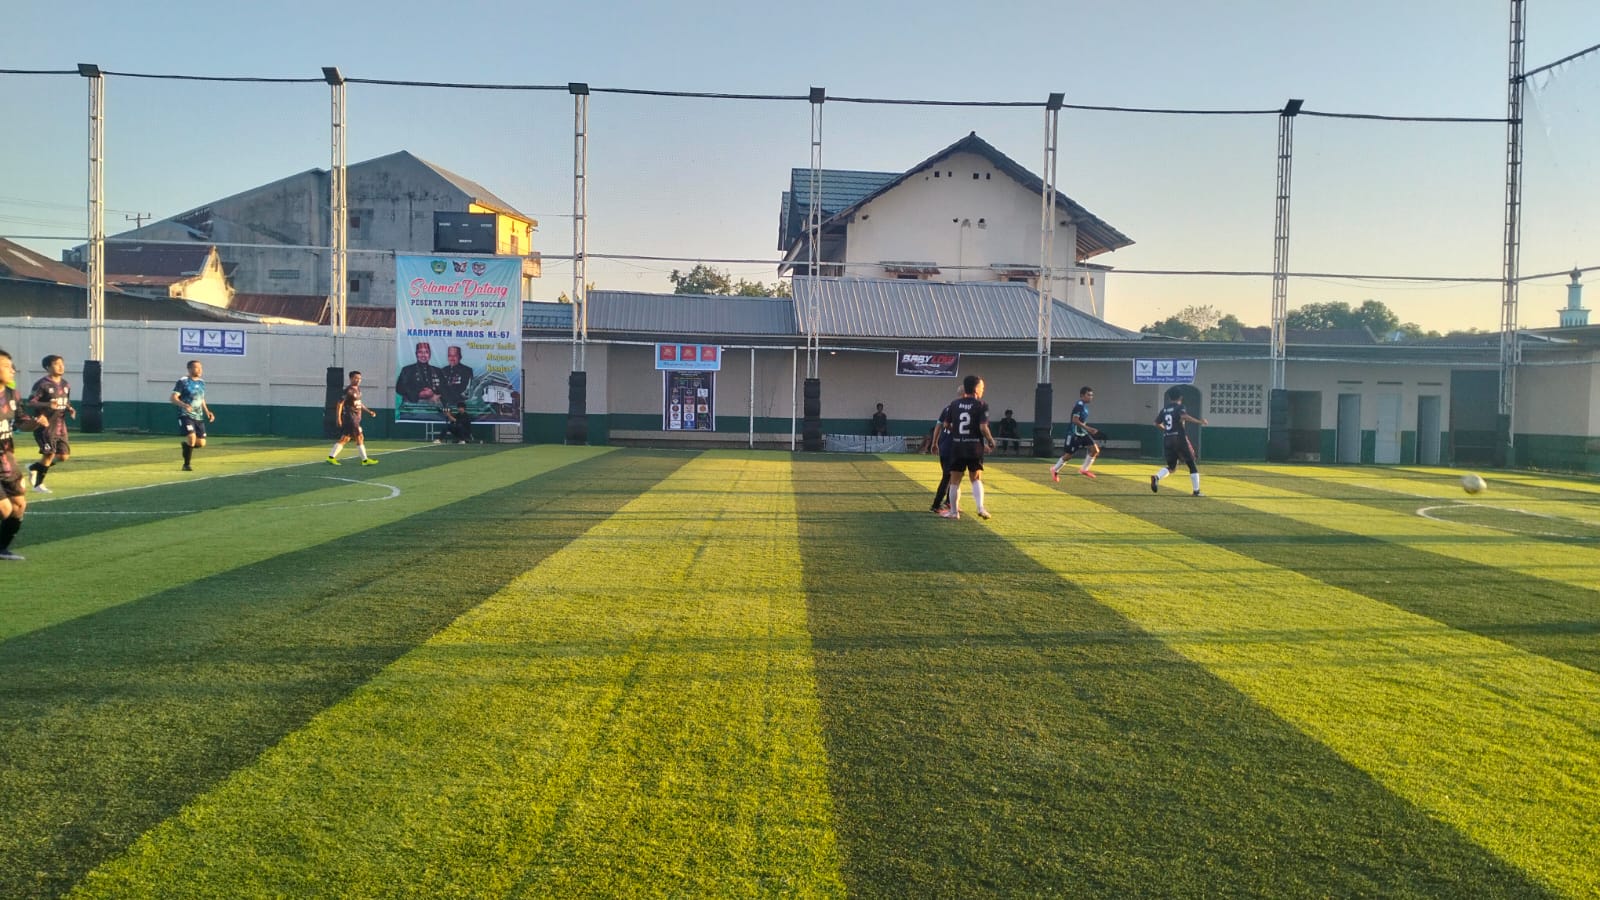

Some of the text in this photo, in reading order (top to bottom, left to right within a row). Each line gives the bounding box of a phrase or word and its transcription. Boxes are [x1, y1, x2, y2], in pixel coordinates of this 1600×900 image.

[410, 278, 508, 298] Selamat Datang
[411, 299, 442, 307] PESERTA
[461, 300, 478, 308] MINI
[432, 308, 460, 316] MAROS
[407, 328, 510, 339] KABUPATEN MAROS KE-67
[959, 412, 971, 434] 2
